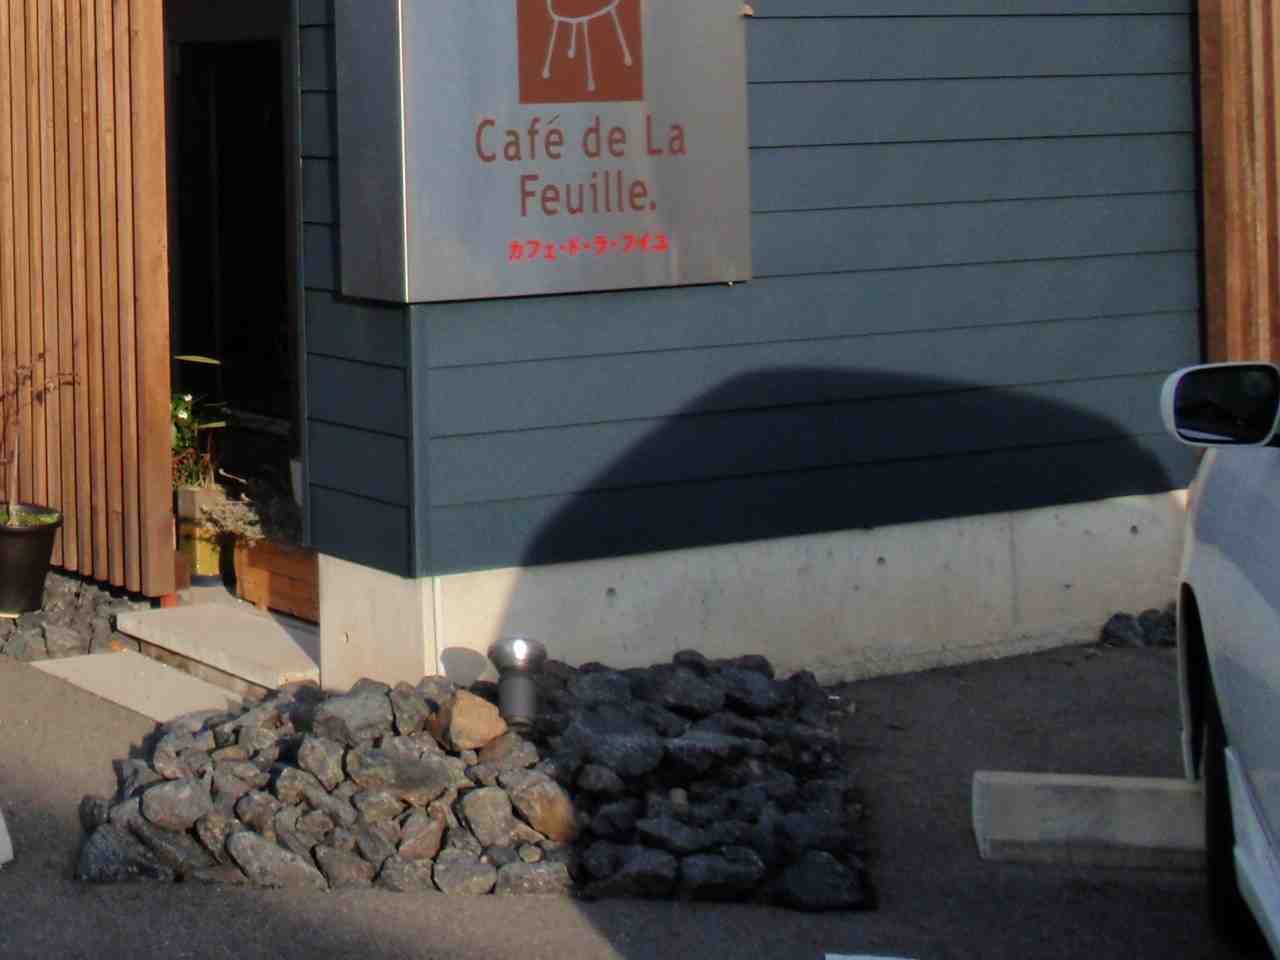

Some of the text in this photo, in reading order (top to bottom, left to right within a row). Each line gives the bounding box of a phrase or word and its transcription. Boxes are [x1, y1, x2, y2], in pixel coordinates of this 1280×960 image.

[474, 113, 687, 162] Café de La
[519, 170, 657, 217] Feuille.
